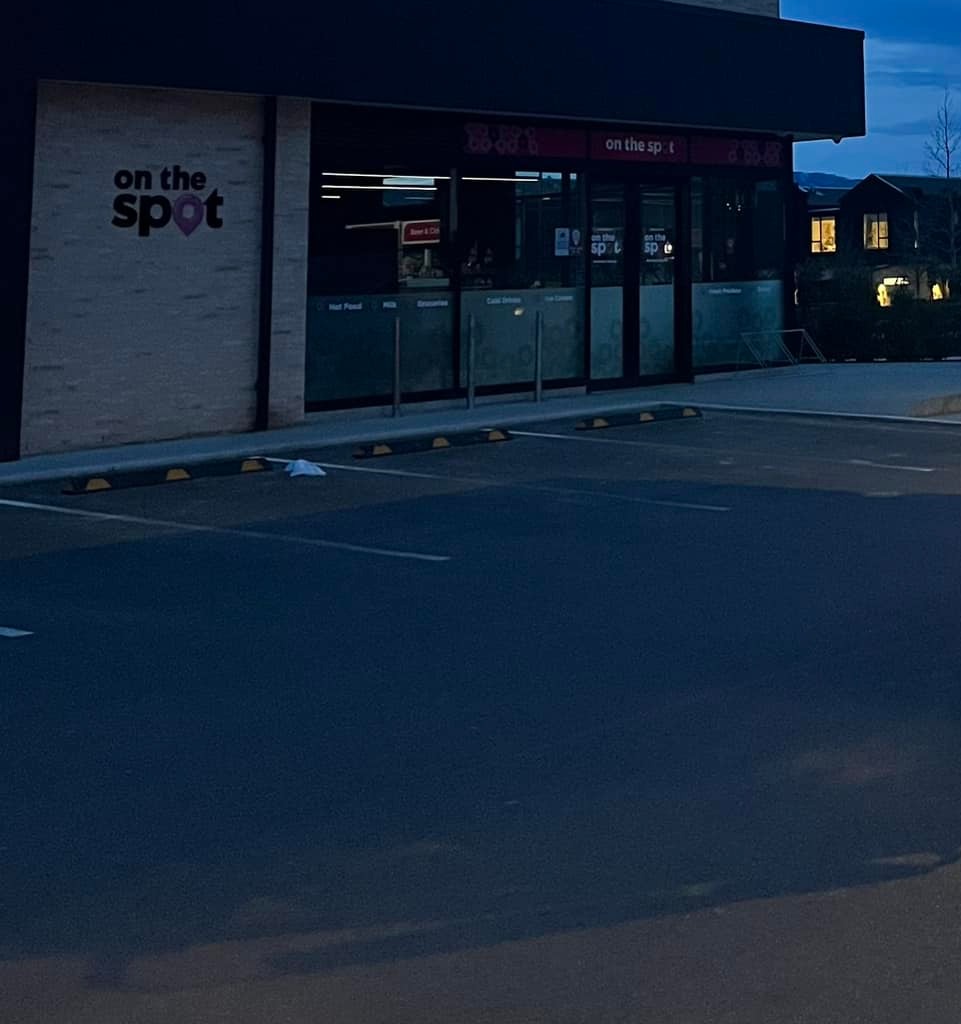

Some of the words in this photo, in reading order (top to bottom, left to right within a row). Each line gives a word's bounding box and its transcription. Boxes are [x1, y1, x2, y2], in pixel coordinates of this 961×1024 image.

[606, 138, 622, 151] on
[624, 136, 645, 151] the
[647, 140, 675, 156] spt
[114, 169, 152, 190] on
[160, 165, 207, 190] the
[112, 188, 224, 237] spot
[591, 240, 621, 256] spt
